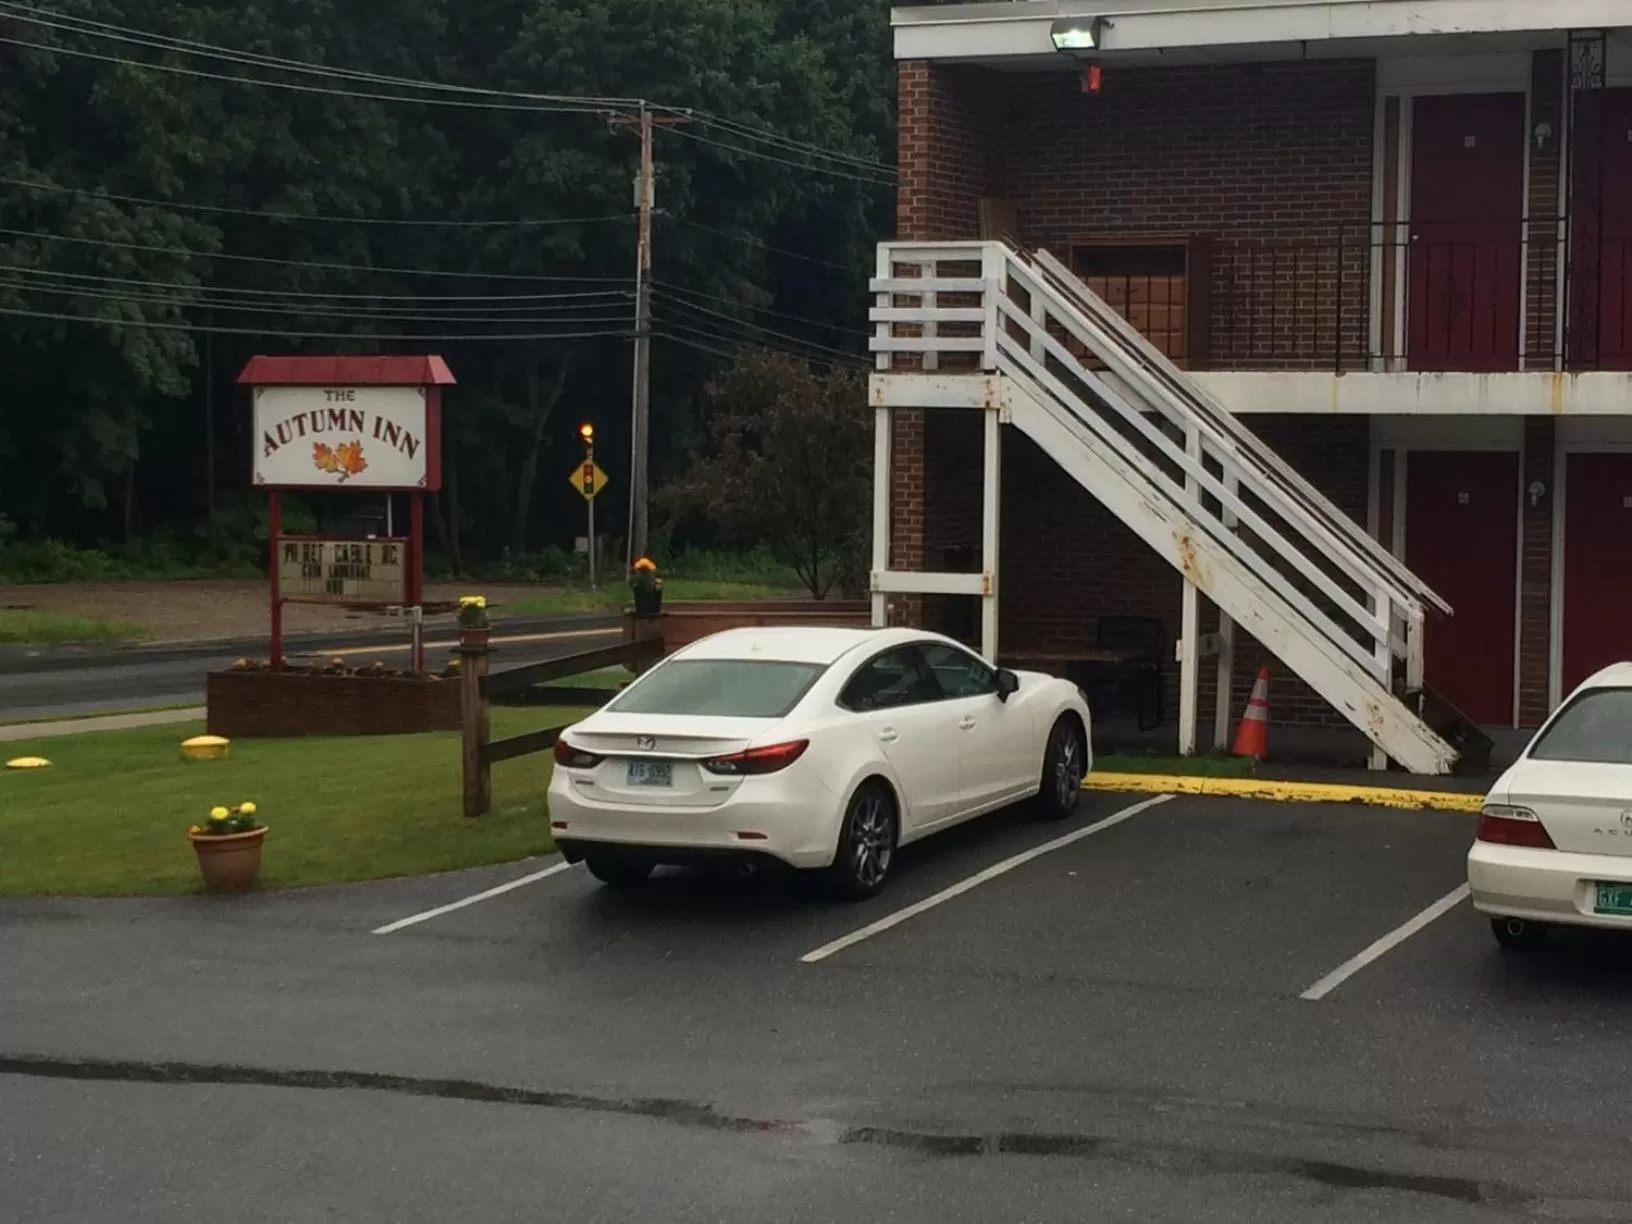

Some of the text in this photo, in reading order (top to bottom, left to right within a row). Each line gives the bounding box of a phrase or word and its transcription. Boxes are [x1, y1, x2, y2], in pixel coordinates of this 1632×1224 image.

[323, 389, 356, 402] THE
[263, 408, 420, 460] AUTUMN INN
